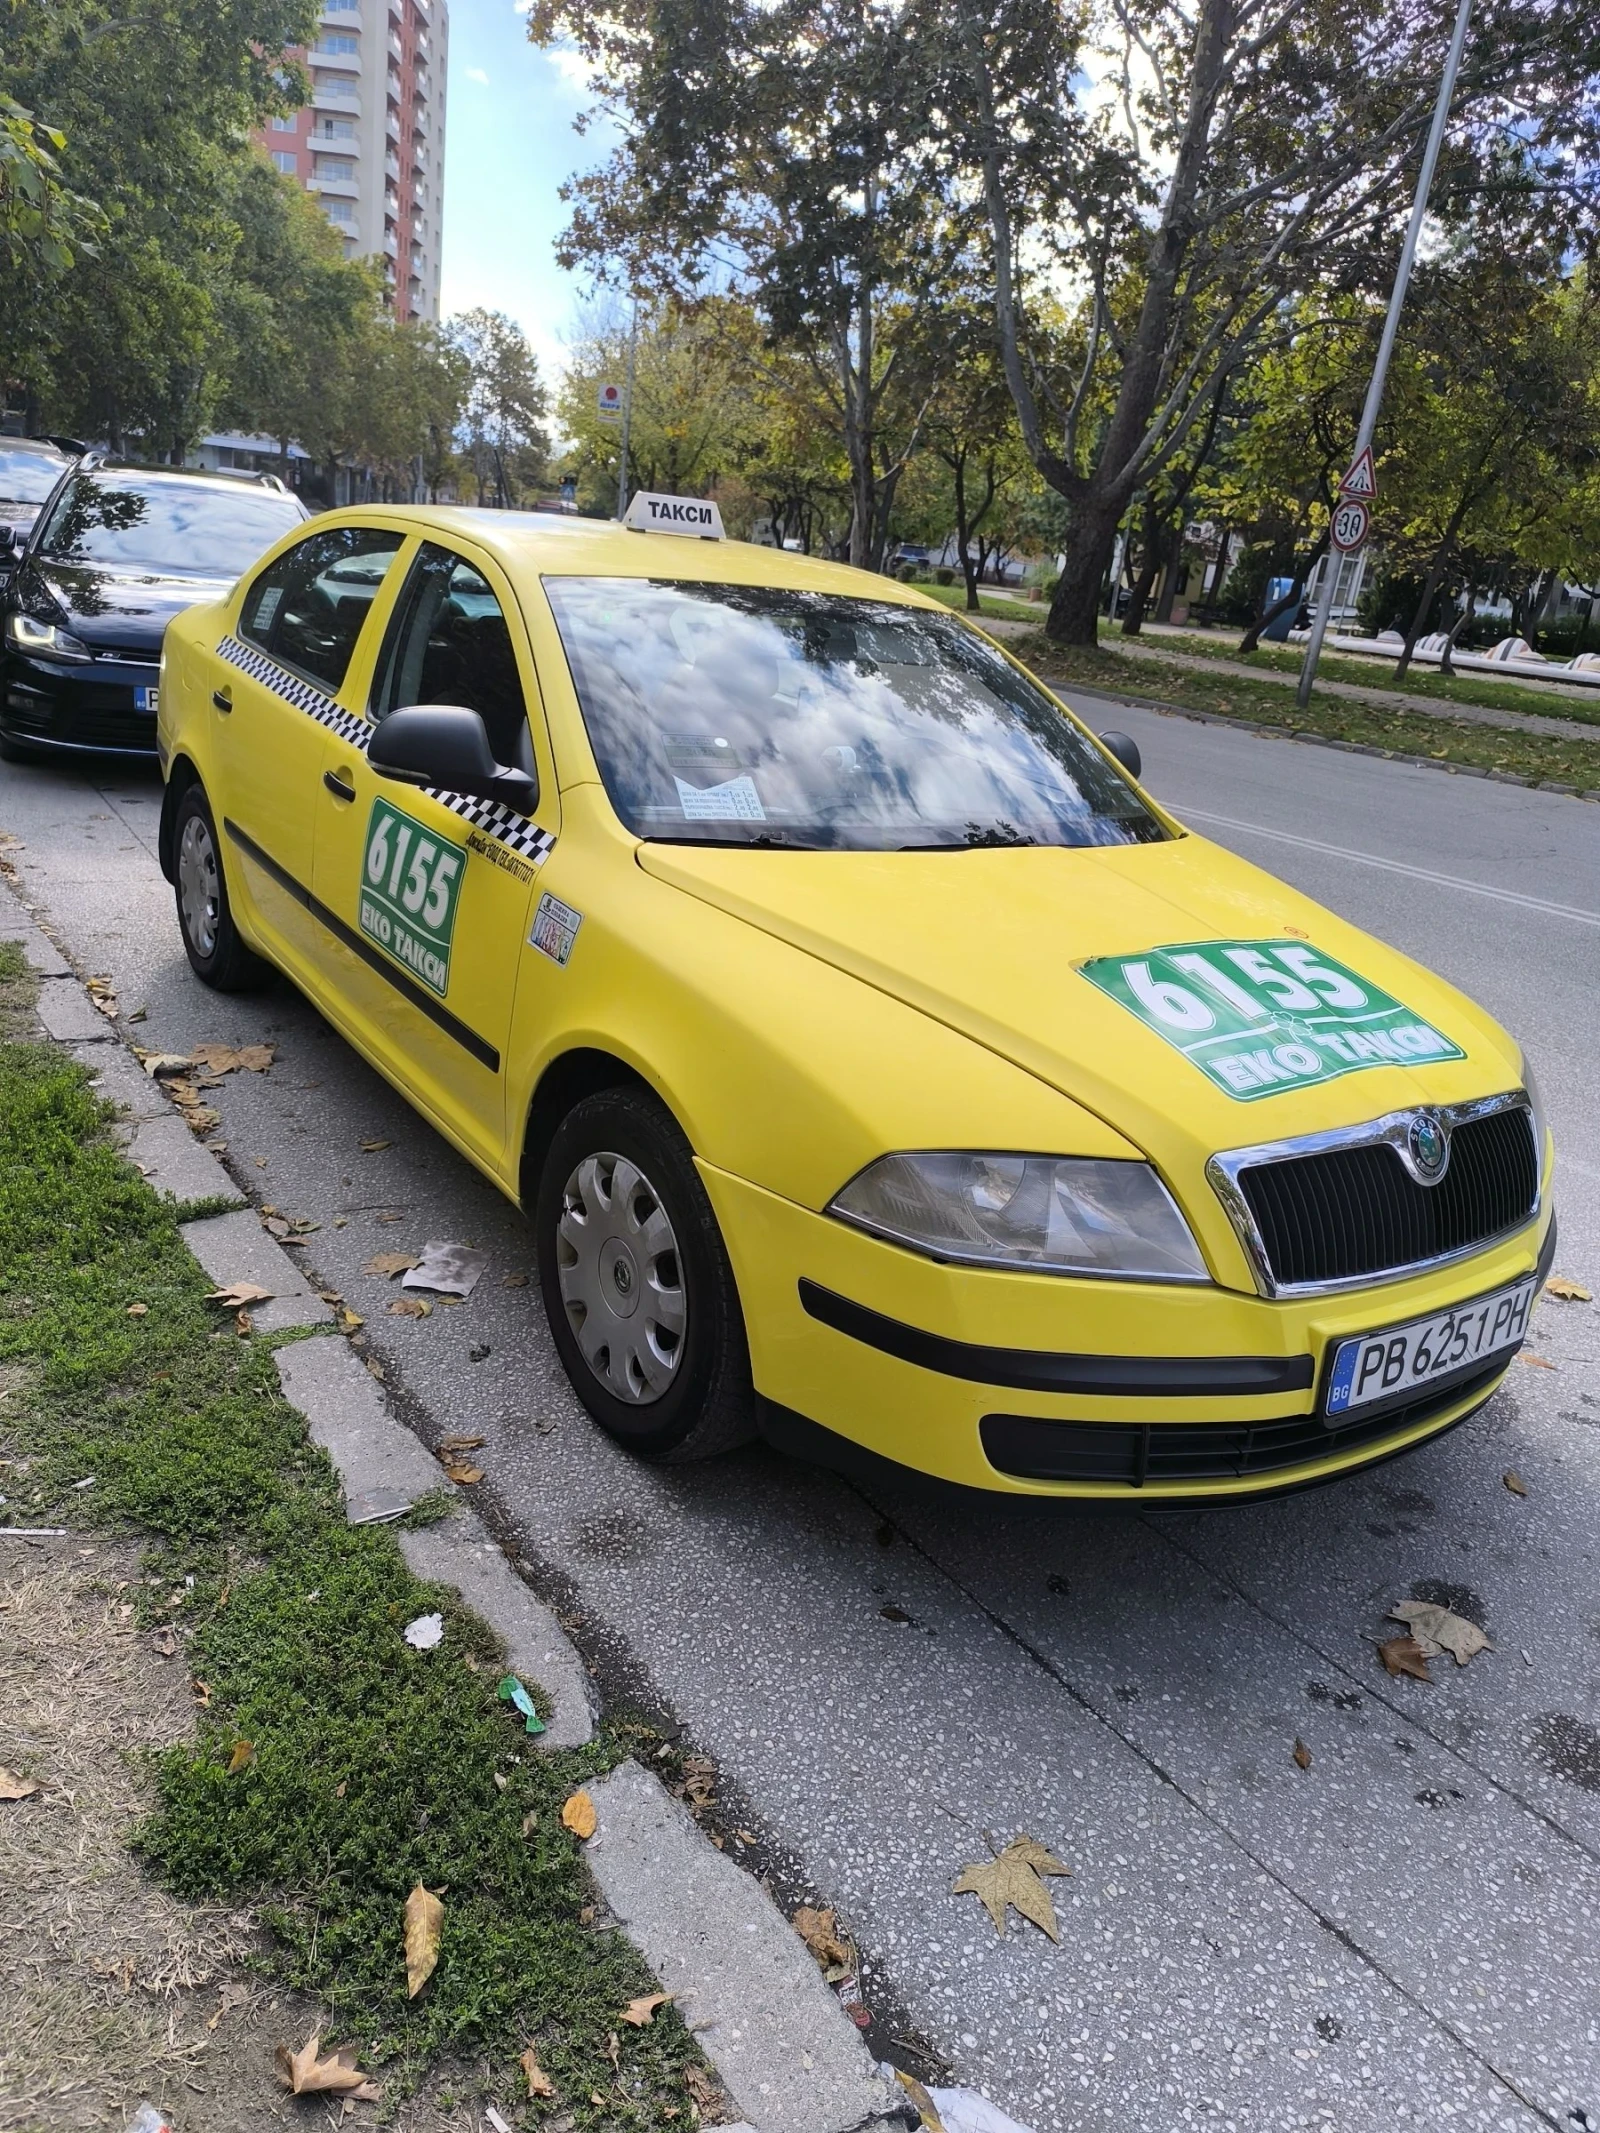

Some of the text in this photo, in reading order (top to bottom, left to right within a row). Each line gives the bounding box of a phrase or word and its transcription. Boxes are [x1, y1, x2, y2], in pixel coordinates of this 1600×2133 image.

[648, 501, 712, 525] ТАКСИ
[1338, 512, 1361, 538] 30
[368, 814, 459, 930] 6155
[361, 899, 446, 990] ЕКО ТАКСИ
[1121, 946, 1369, 1032] 6155
[1206, 1024, 1457, 1092] ЕКО ТАКСИ
[1332, 1288, 1531, 1403] BG PB 6251 PH
